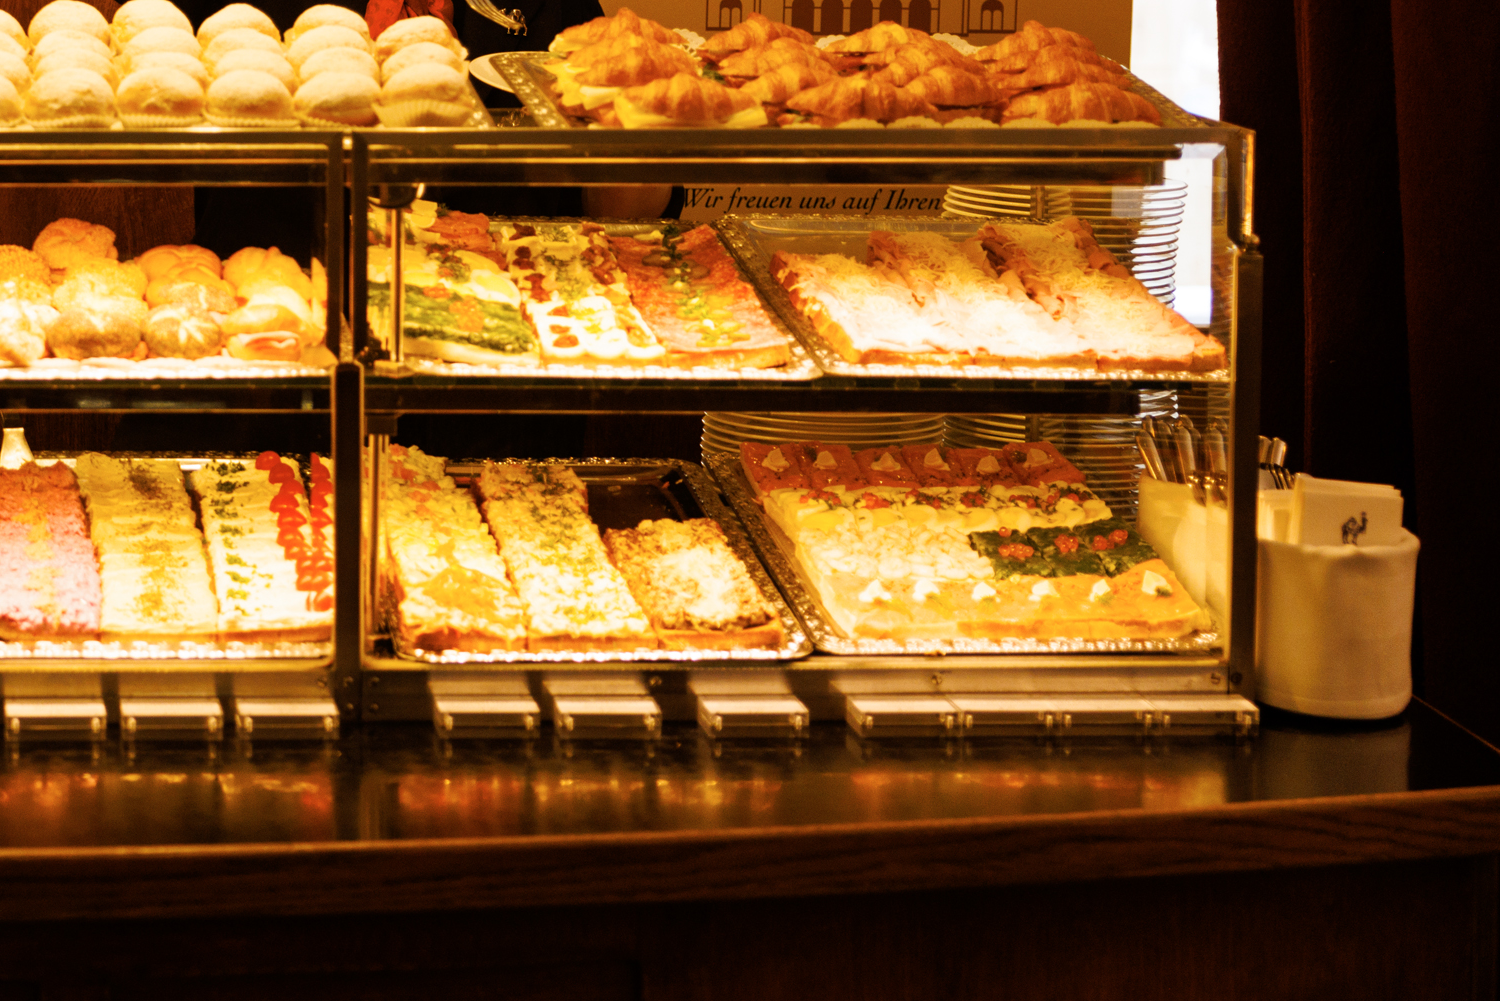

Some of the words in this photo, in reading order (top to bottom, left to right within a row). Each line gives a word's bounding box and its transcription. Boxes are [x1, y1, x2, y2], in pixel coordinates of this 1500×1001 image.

[684, 187, 724, 209] Wir
[723, 187, 793, 214] freuen
[799, 195, 836, 209] uns
[842, 188, 883, 215] auf
[883, 188, 942, 211] Ihren
